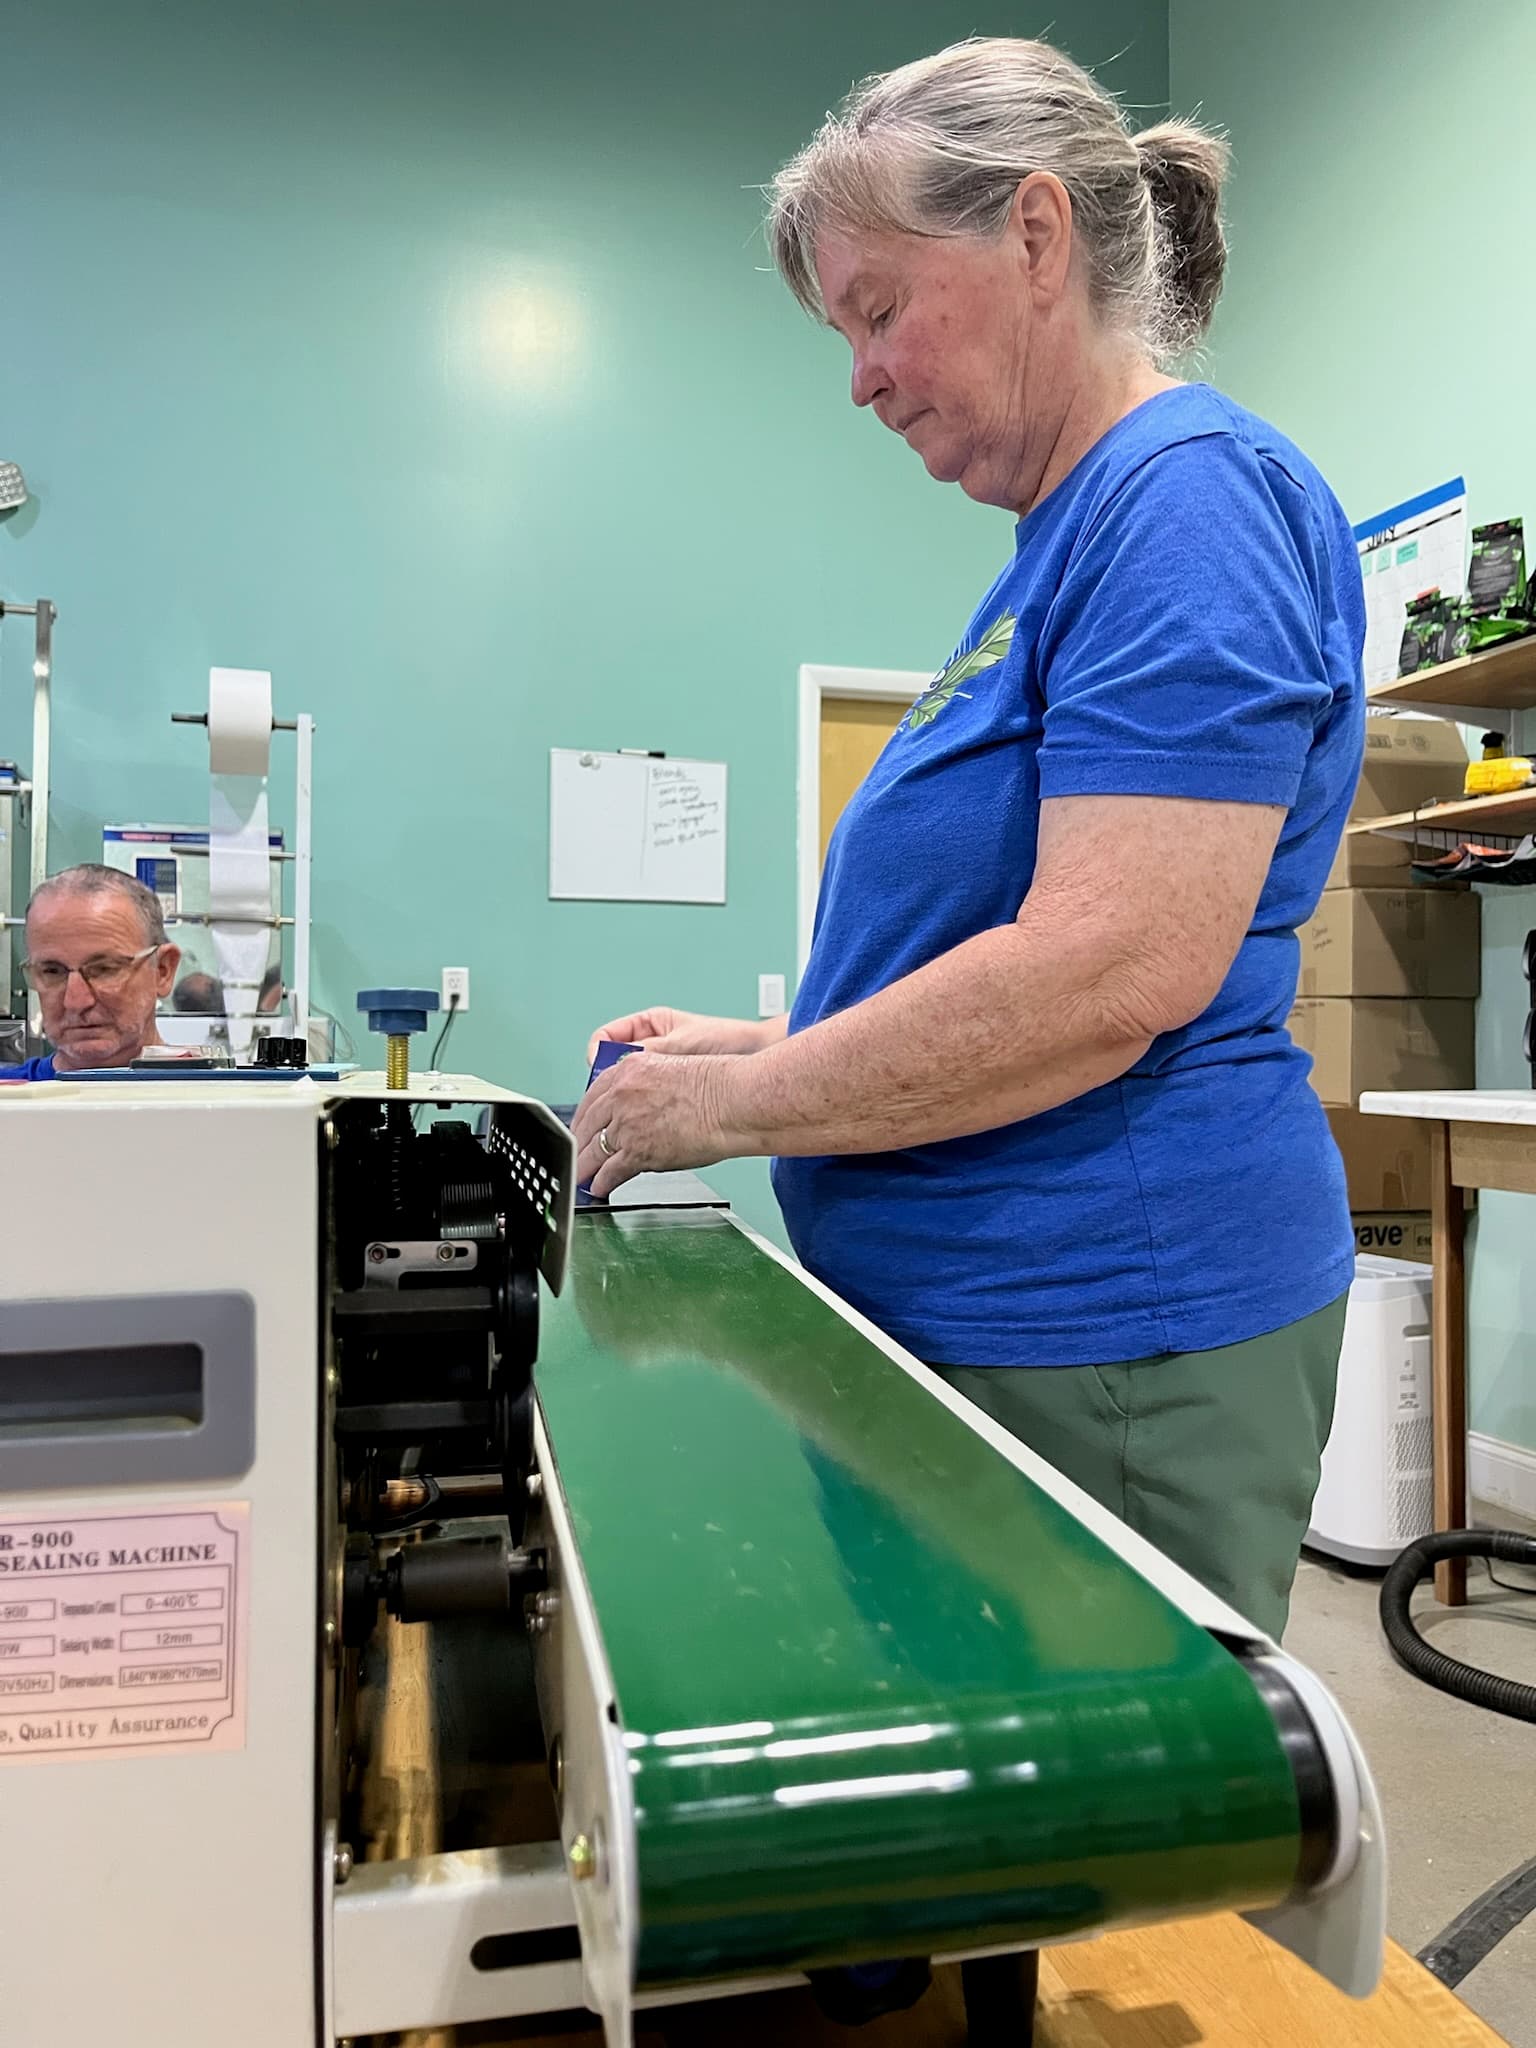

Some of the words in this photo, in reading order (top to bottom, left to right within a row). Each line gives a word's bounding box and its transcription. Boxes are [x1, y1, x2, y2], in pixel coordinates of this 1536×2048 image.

[1367, 524, 1396, 550] JULY
[1354, 1225, 1402, 1247] ave
[0, 1552, 100, 1572] SEALING
[108, 1544, 216, 1566] MACHINE
[157, 1633, 193, 1645] 12mm
[19, 1719, 98, 1741] Quality
[109, 1715, 209, 1734] Assurance
